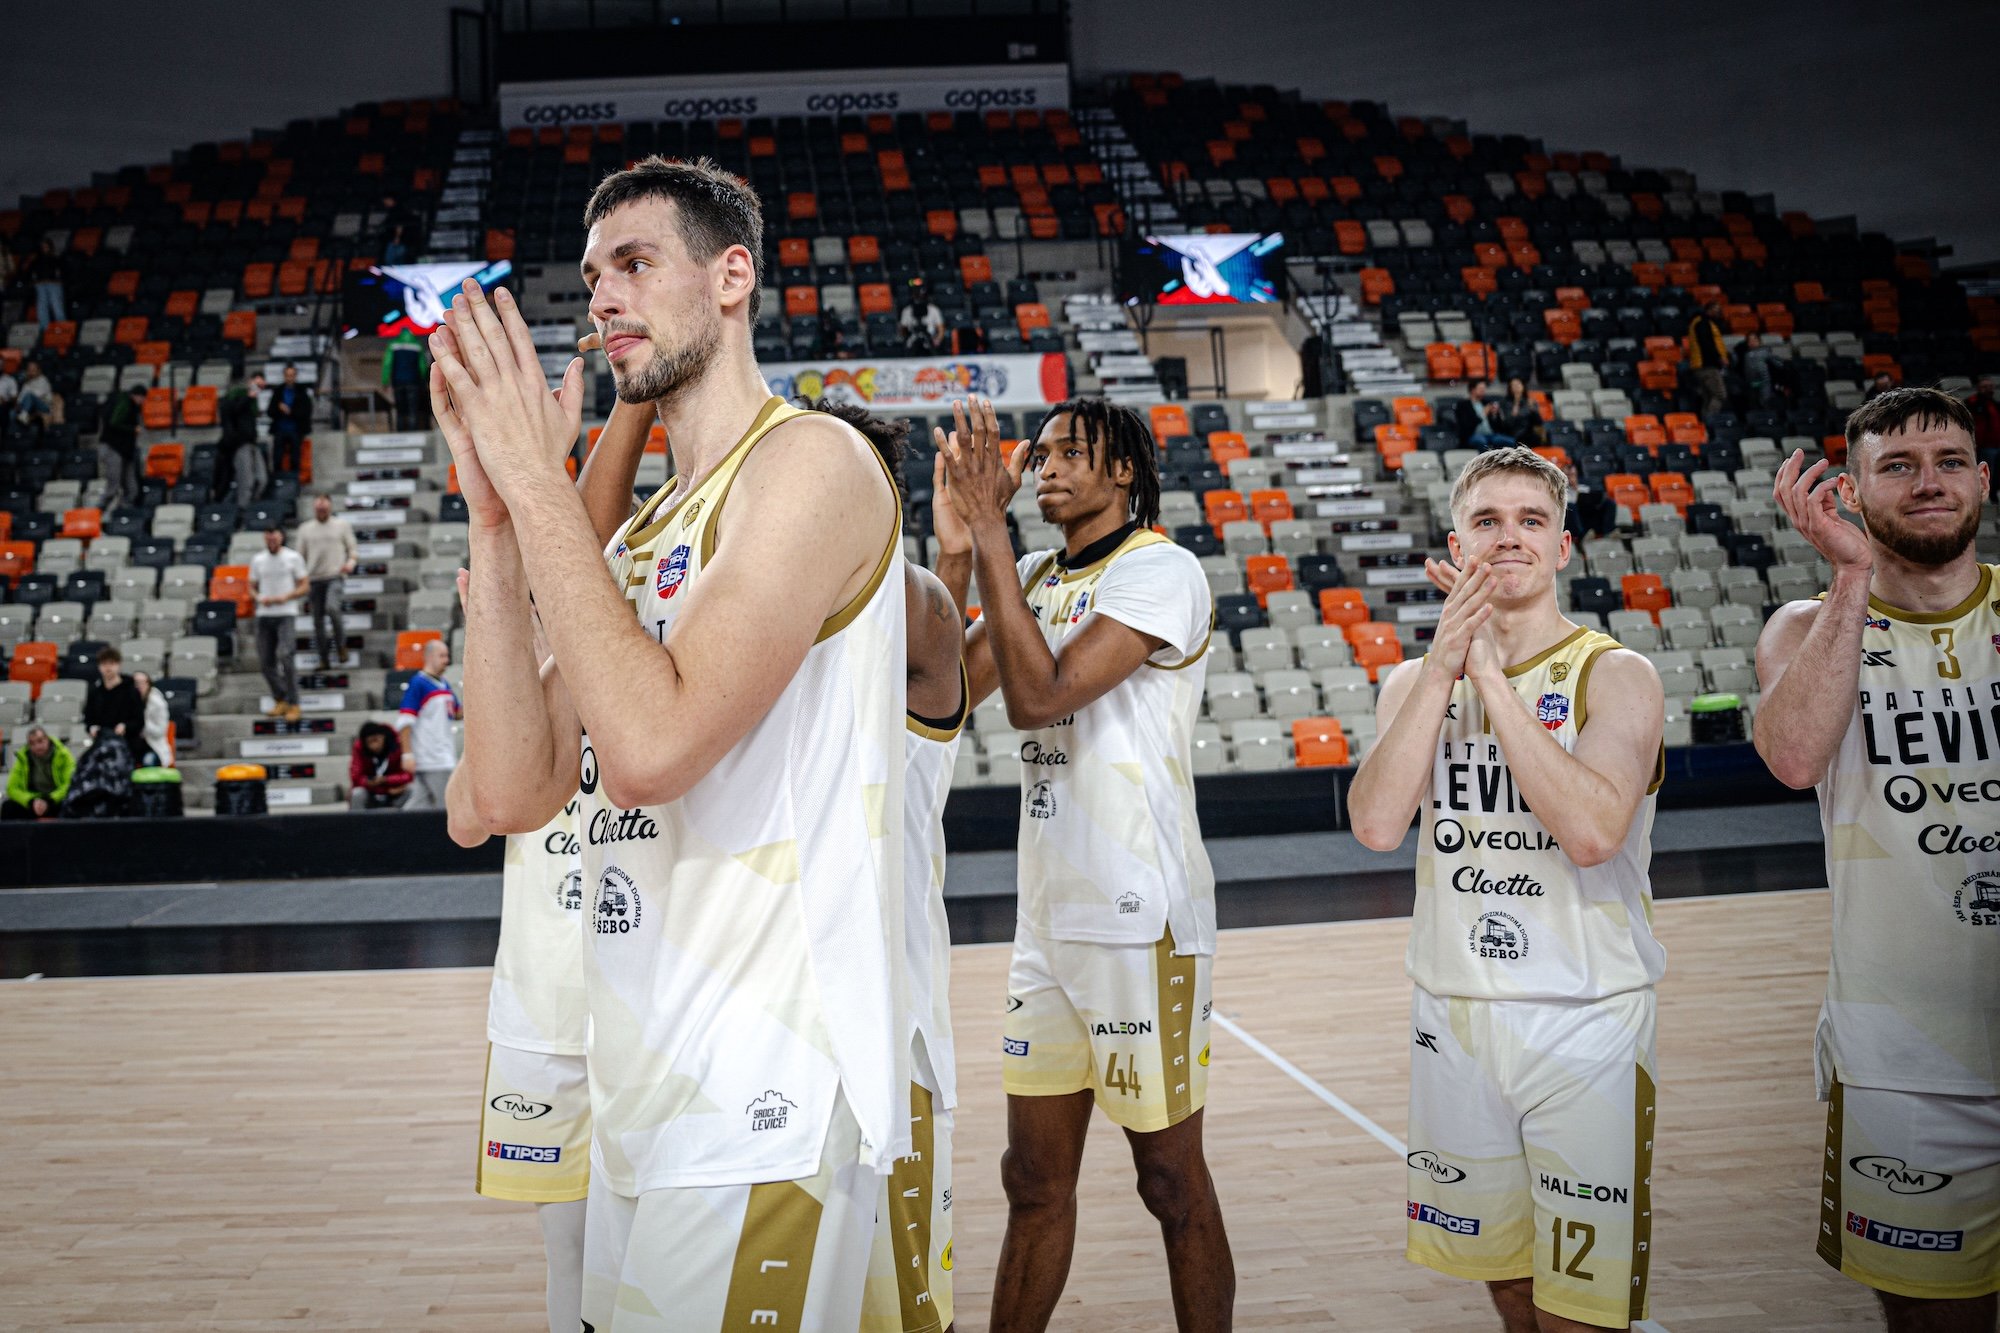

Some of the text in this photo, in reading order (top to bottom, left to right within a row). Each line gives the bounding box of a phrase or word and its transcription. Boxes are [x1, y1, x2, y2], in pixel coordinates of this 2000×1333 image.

[1930, 628, 1961, 680] 3
[1538, 706, 1566, 721] SBL
[1433, 763, 1532, 813] EVI
[1451, 865, 1546, 897] Cloetta
[1971, 911, 2000, 926] ŠE
[1480, 945, 1519, 960] ŠEBO
[1003, 1039, 1026, 1055] POS
[1105, 1052, 1142, 1099] 44
[504, 1100, 534, 1114] TAM
[752, 1116, 787, 1131] LEVICE!
[503, 1145, 557, 1162] TIPOS
[1420, 1156, 1449, 1178] TAM
[1822, 1100, 1836, 1237] PATRIO
[1871, 1162, 1925, 1187] TAM
[1539, 1172, 1628, 1204] HALEON
[1423, 1205, 1476, 1234] TIPOS
[1551, 1216, 1596, 1281] 12
[1873, 1222, 1958, 1250] TIPOS
